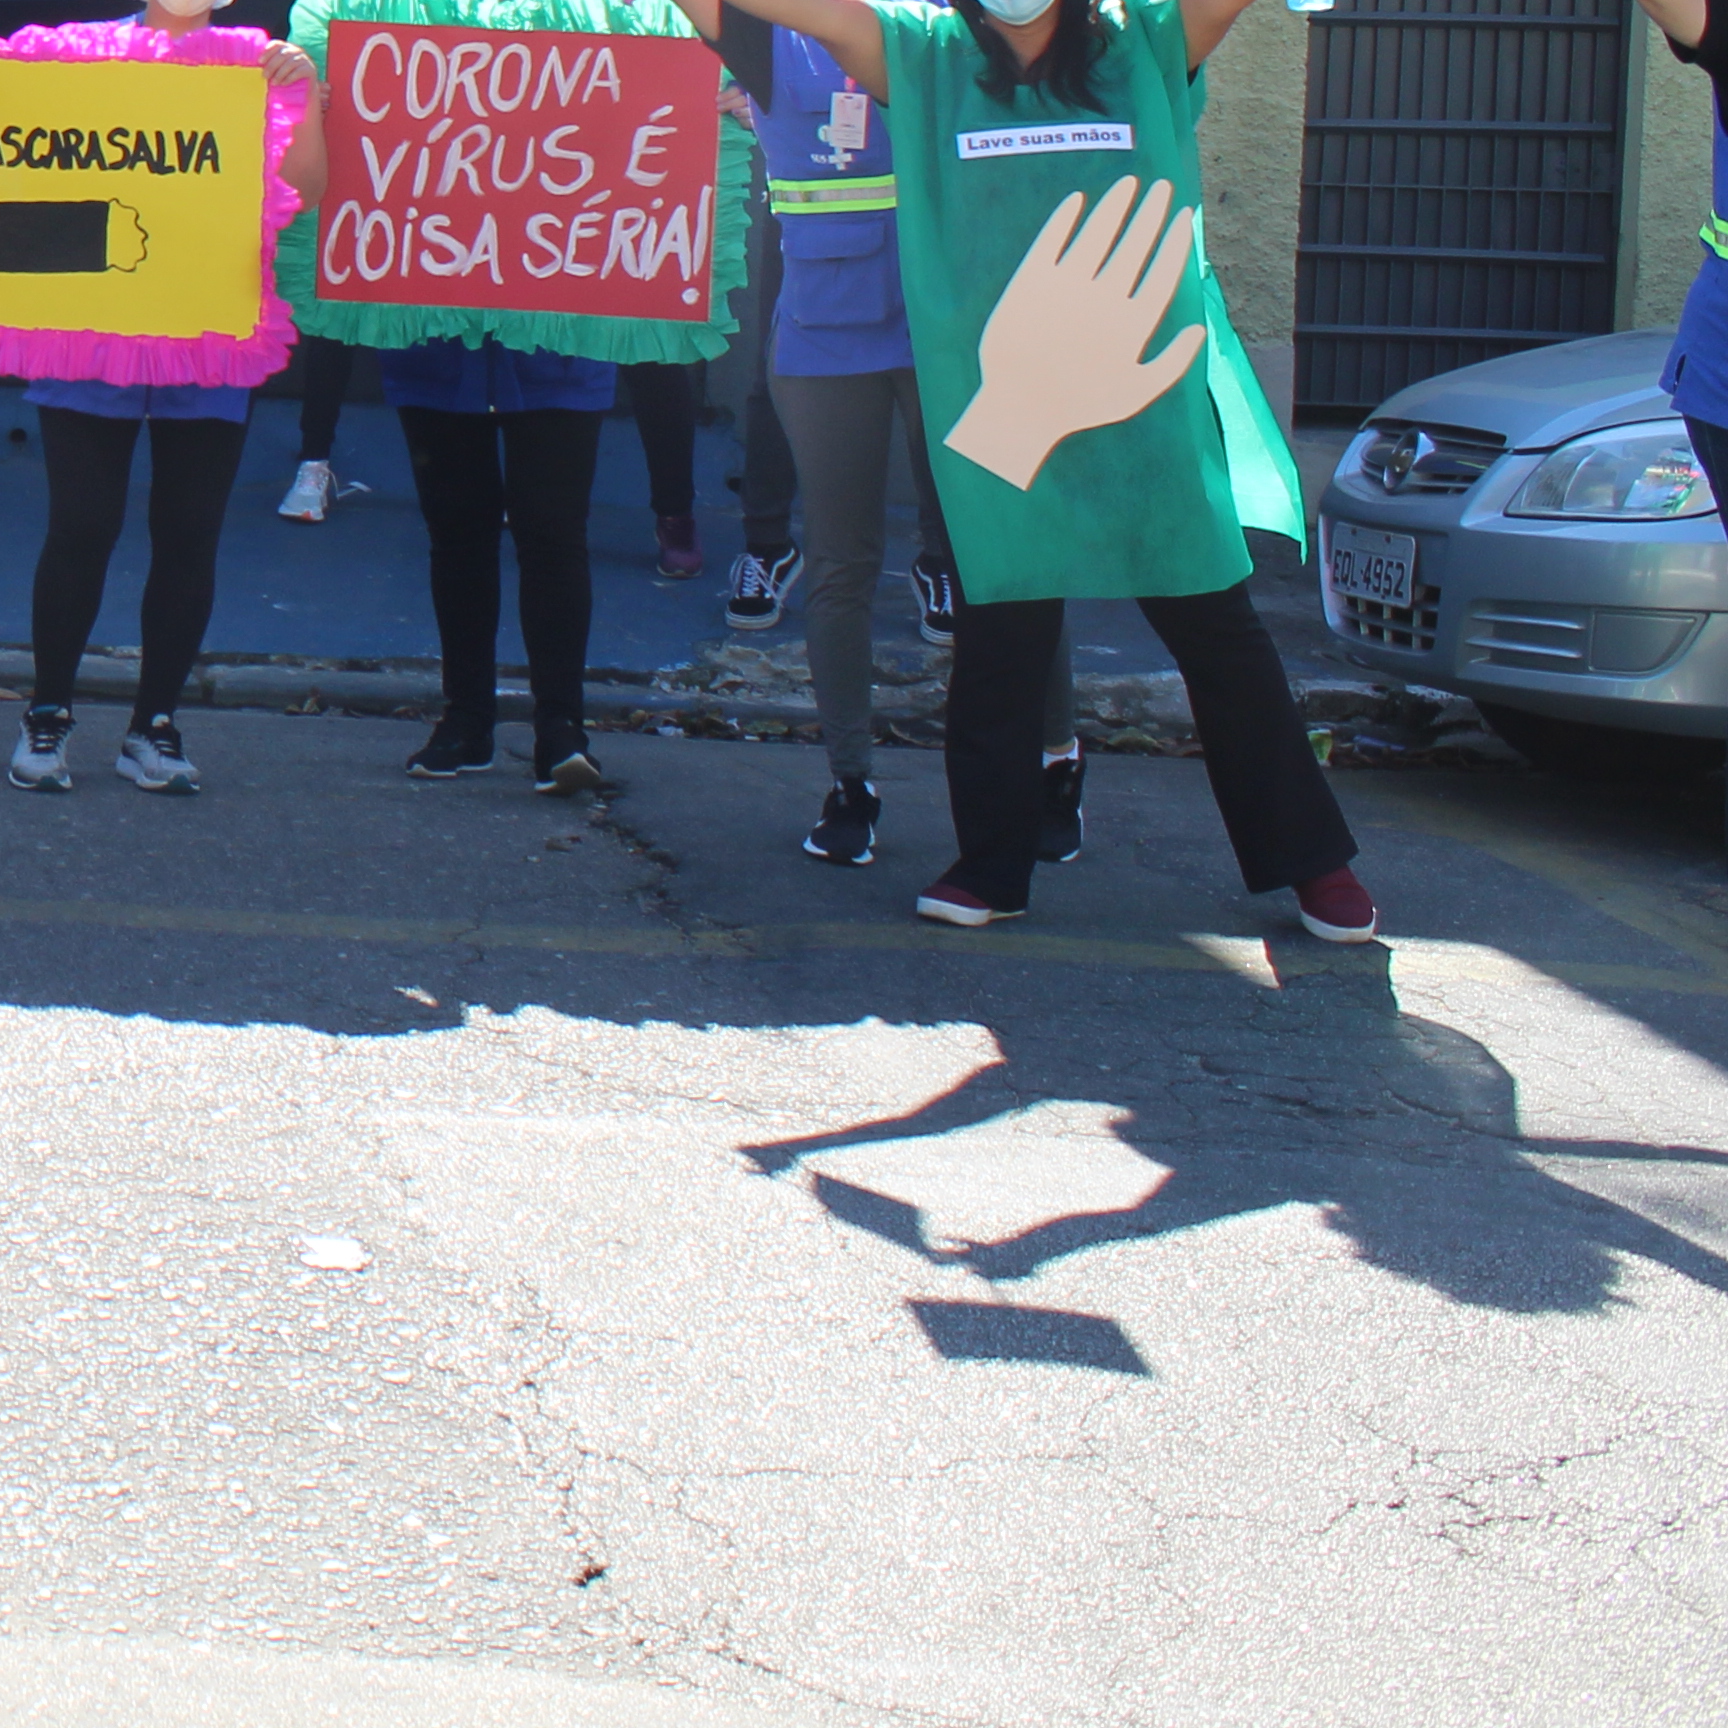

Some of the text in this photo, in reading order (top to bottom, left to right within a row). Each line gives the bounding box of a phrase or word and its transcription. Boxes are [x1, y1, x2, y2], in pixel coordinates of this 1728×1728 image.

[352, 32, 621, 123] CORONA
[360, 106, 678, 202] VÍRUS É
[966, 128, 1122, 150] Lave suas mãos
